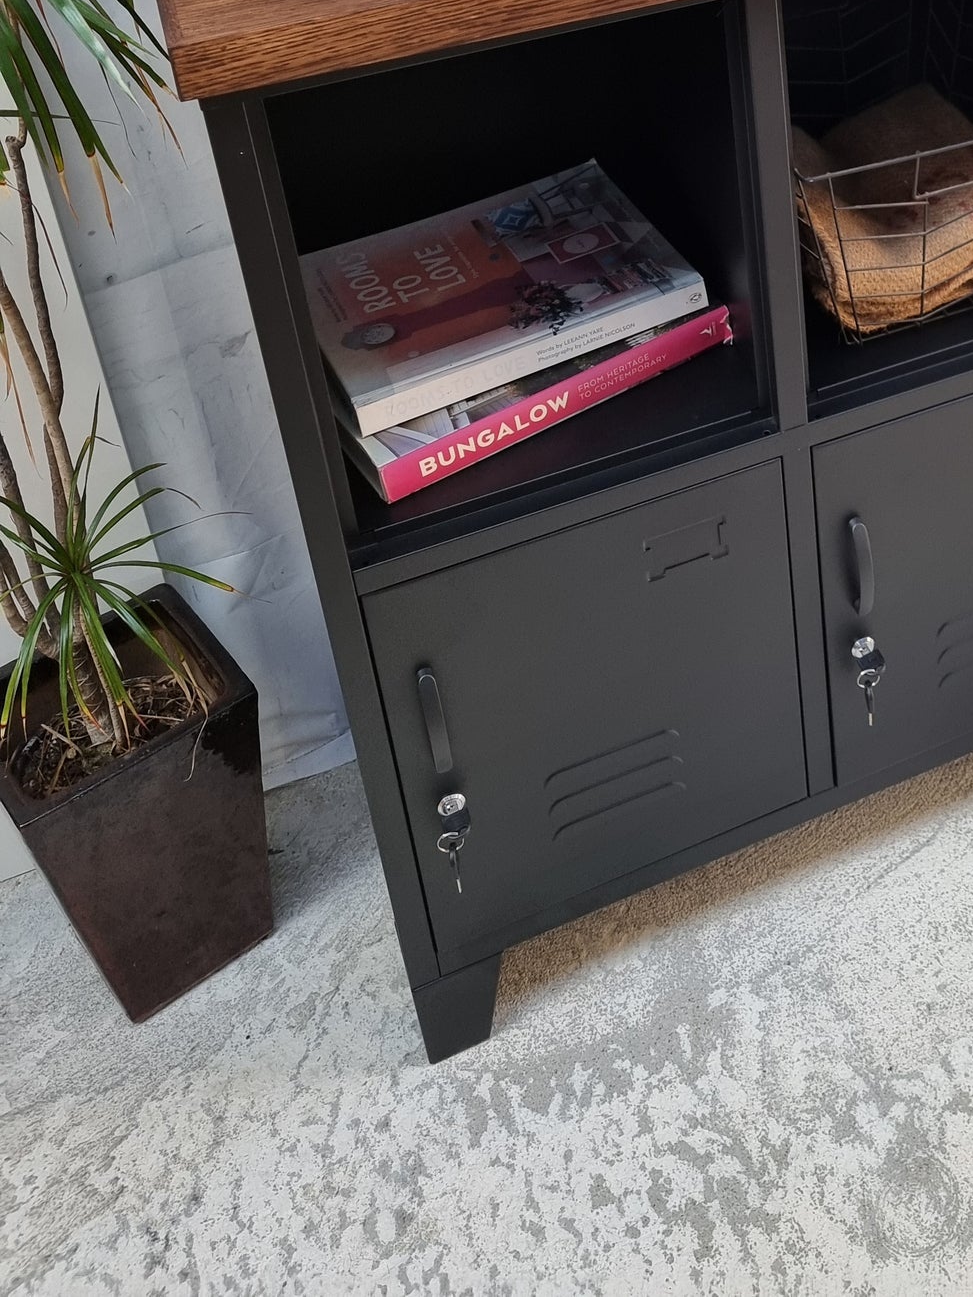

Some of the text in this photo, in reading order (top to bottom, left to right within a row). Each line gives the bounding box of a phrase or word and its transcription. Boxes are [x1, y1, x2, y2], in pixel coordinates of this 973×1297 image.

[336, 252, 396, 313] ROOMS
[414, 244, 466, 291] LOVE
[393, 275, 430, 303] TO
[538, 345, 574, 362] Photography
[574, 342, 582, 351] by
[605, 322, 636, 338] NICOLSON
[556, 342, 563, 350] by
[483, 355, 526, 382] LOVE
[578, 352, 650, 392] FROM HERITAGE
[580, 353, 667, 400] TO CONTEMPORARY
[418, 390, 570, 478] BUNGALOW
